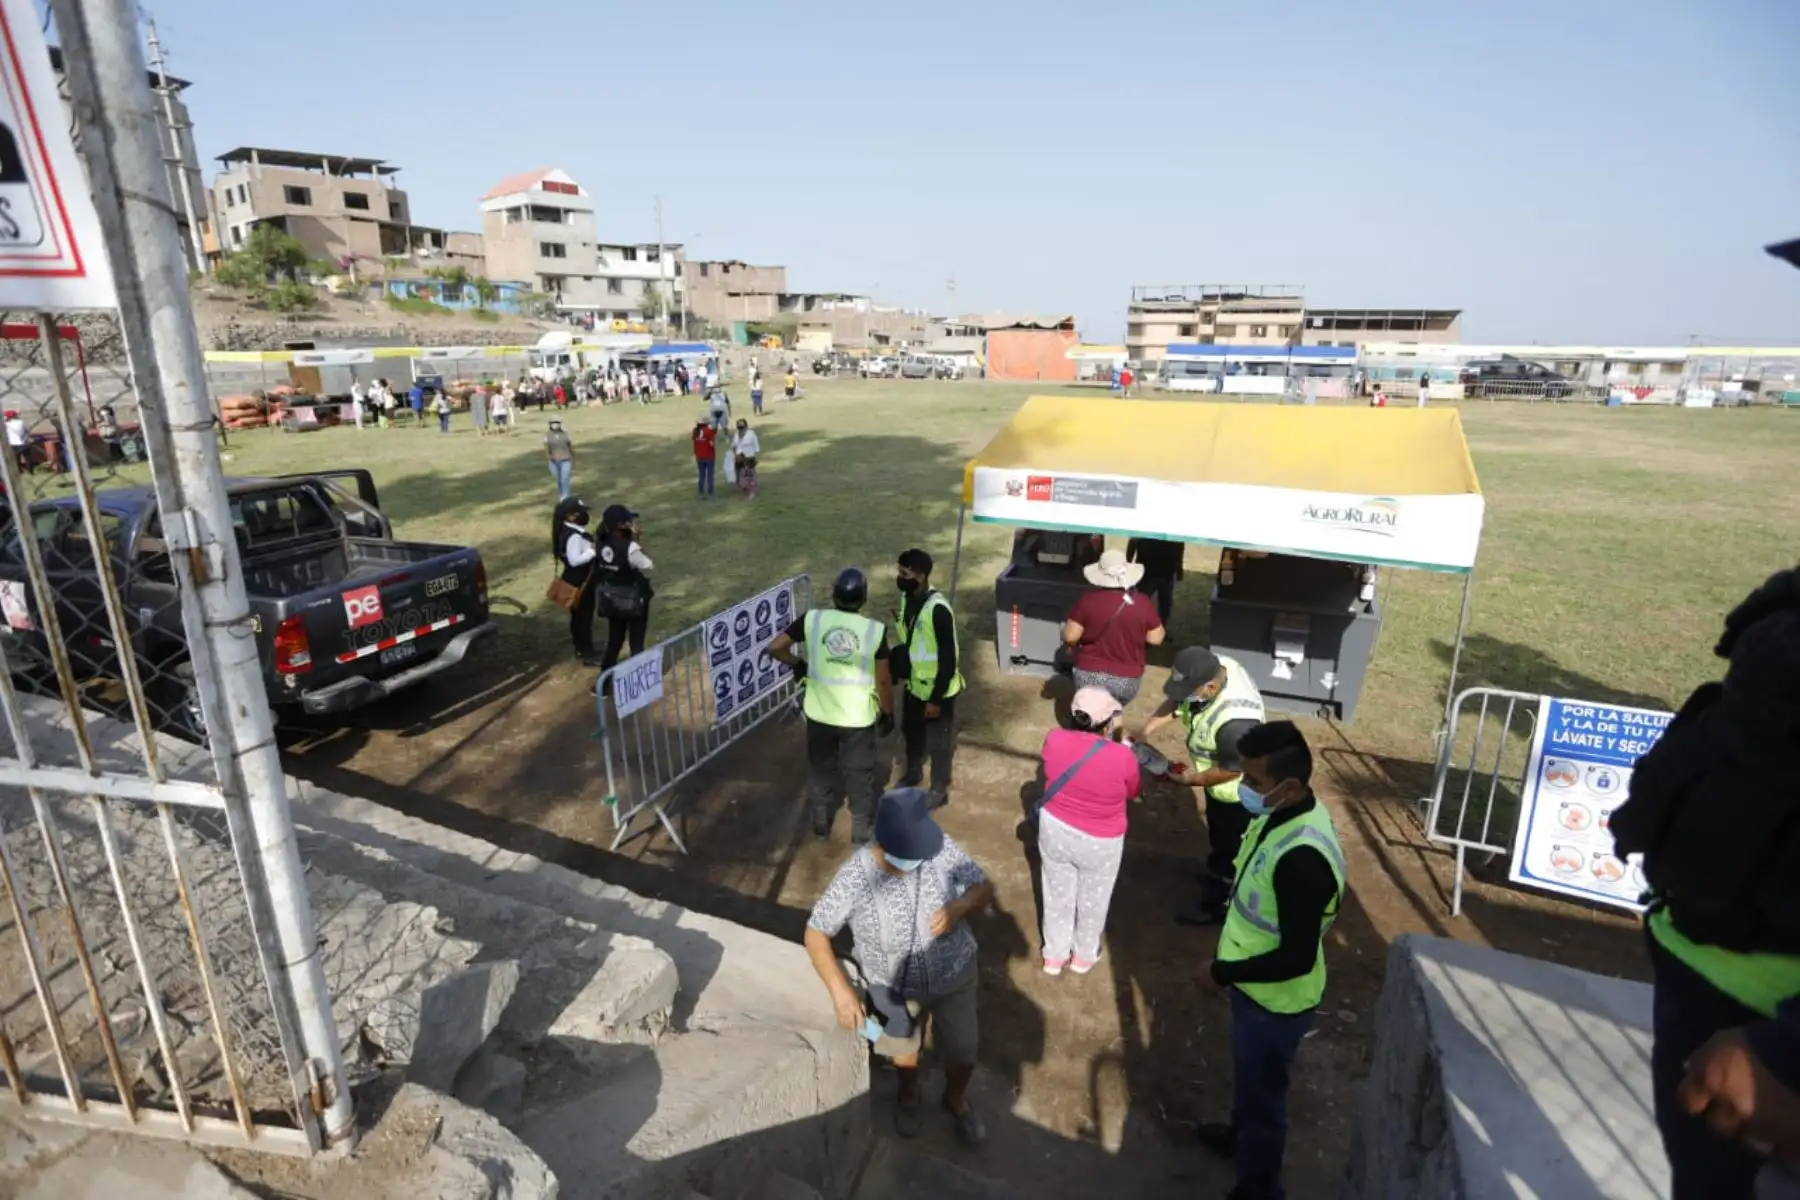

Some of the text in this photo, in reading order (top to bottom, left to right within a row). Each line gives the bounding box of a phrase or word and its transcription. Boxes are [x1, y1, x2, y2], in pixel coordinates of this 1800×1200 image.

[344, 594, 380, 626] pe
[343, 597, 453, 651] TOYOTA
[1563, 705, 1595, 718] POR
[1599, 709, 1618, 721] LA
[1552, 727, 1604, 749] LÁVATE
[1607, 738, 1617, 750] Y
[1562, 717, 1570, 726] Y
[1574, 719, 1593, 730] LA
[1597, 722, 1618, 733] DE
[1624, 724, 1642, 737] TU
